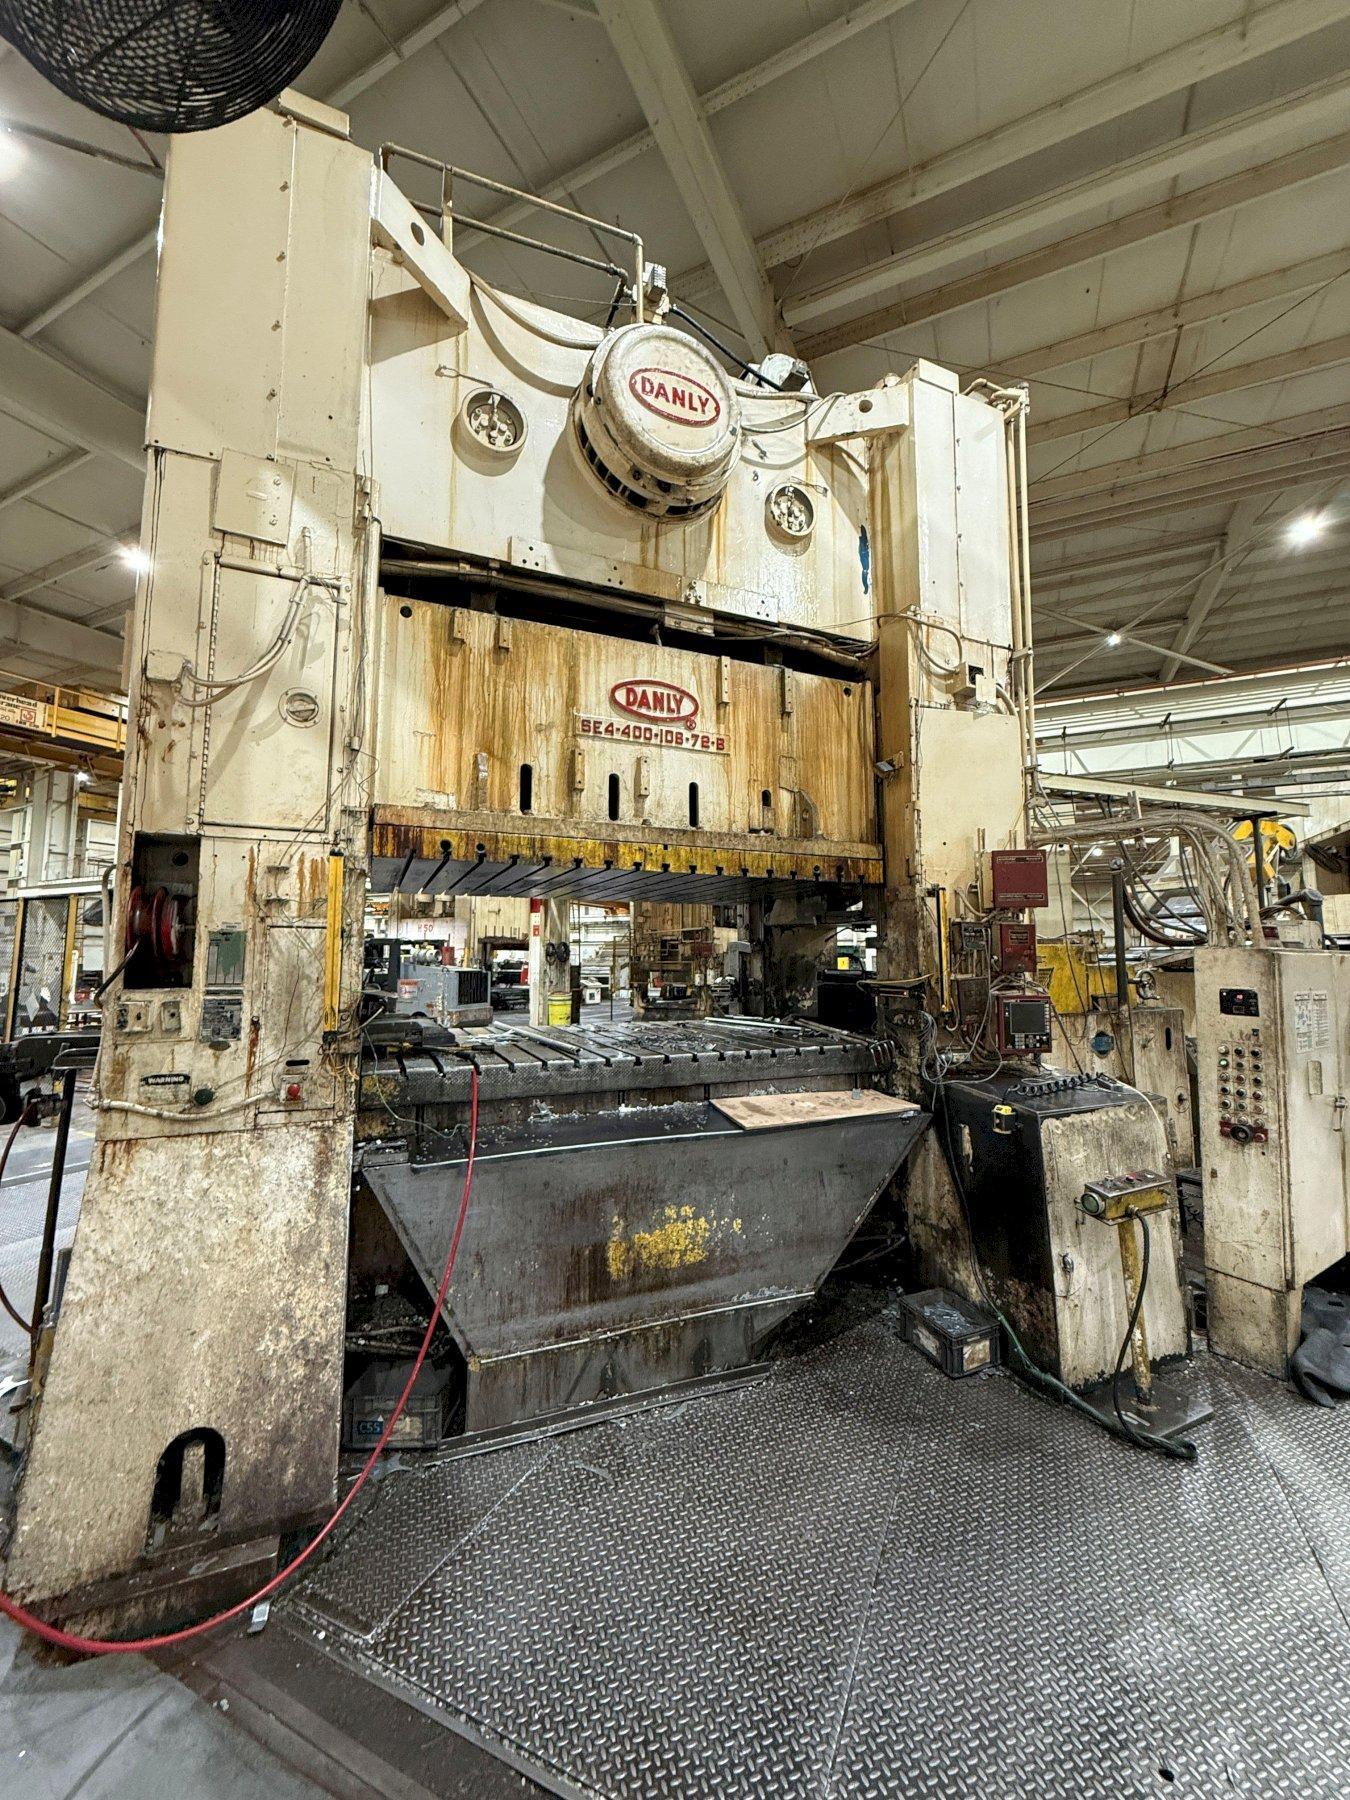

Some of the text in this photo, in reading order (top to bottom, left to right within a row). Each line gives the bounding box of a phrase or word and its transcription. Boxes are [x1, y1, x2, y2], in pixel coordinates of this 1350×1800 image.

[641, 375, 710, 415] DANLY
[0, 694, 37, 708] verhead
[0, 701, 20, 709] rane
[625, 686, 685, 715] DANLY
[147, 1075, 185, 1084] WARNING
